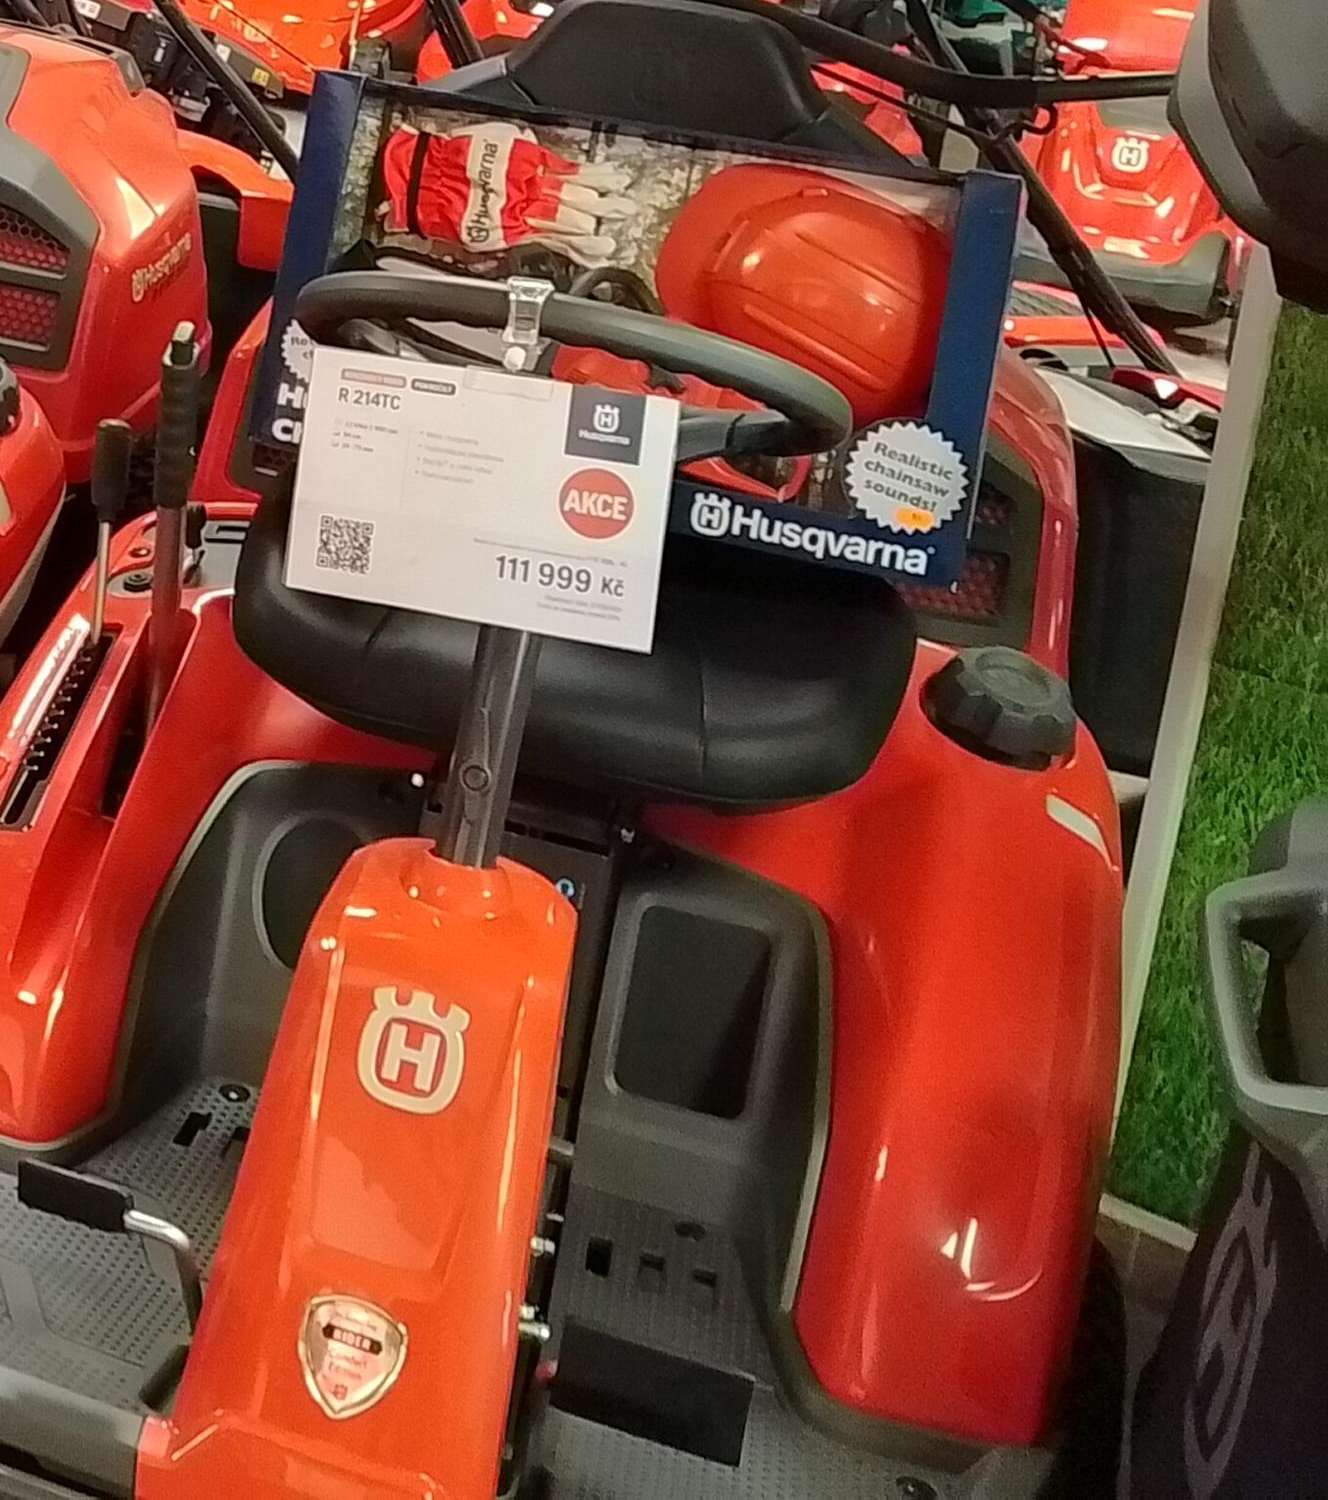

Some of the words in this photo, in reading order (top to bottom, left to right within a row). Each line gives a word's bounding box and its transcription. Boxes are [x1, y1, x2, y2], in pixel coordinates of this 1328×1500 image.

[473, 142, 500, 226] Husqvarna
[338, 387, 350, 404] R
[352, 389, 401, 411] 214TC
[863, 458, 950, 498] chainsaw
[872, 440, 954, 482] Realistic
[562, 489, 629, 522] AKCE
[863, 476, 938, 513] sounds!
[730, 502, 931, 577] Husqvarna
[495, 554, 530, 583] 111
[538, 562, 592, 594] 999
[600, 574, 625, 598] Kč
[333, 1328, 372, 1351] RIDER
